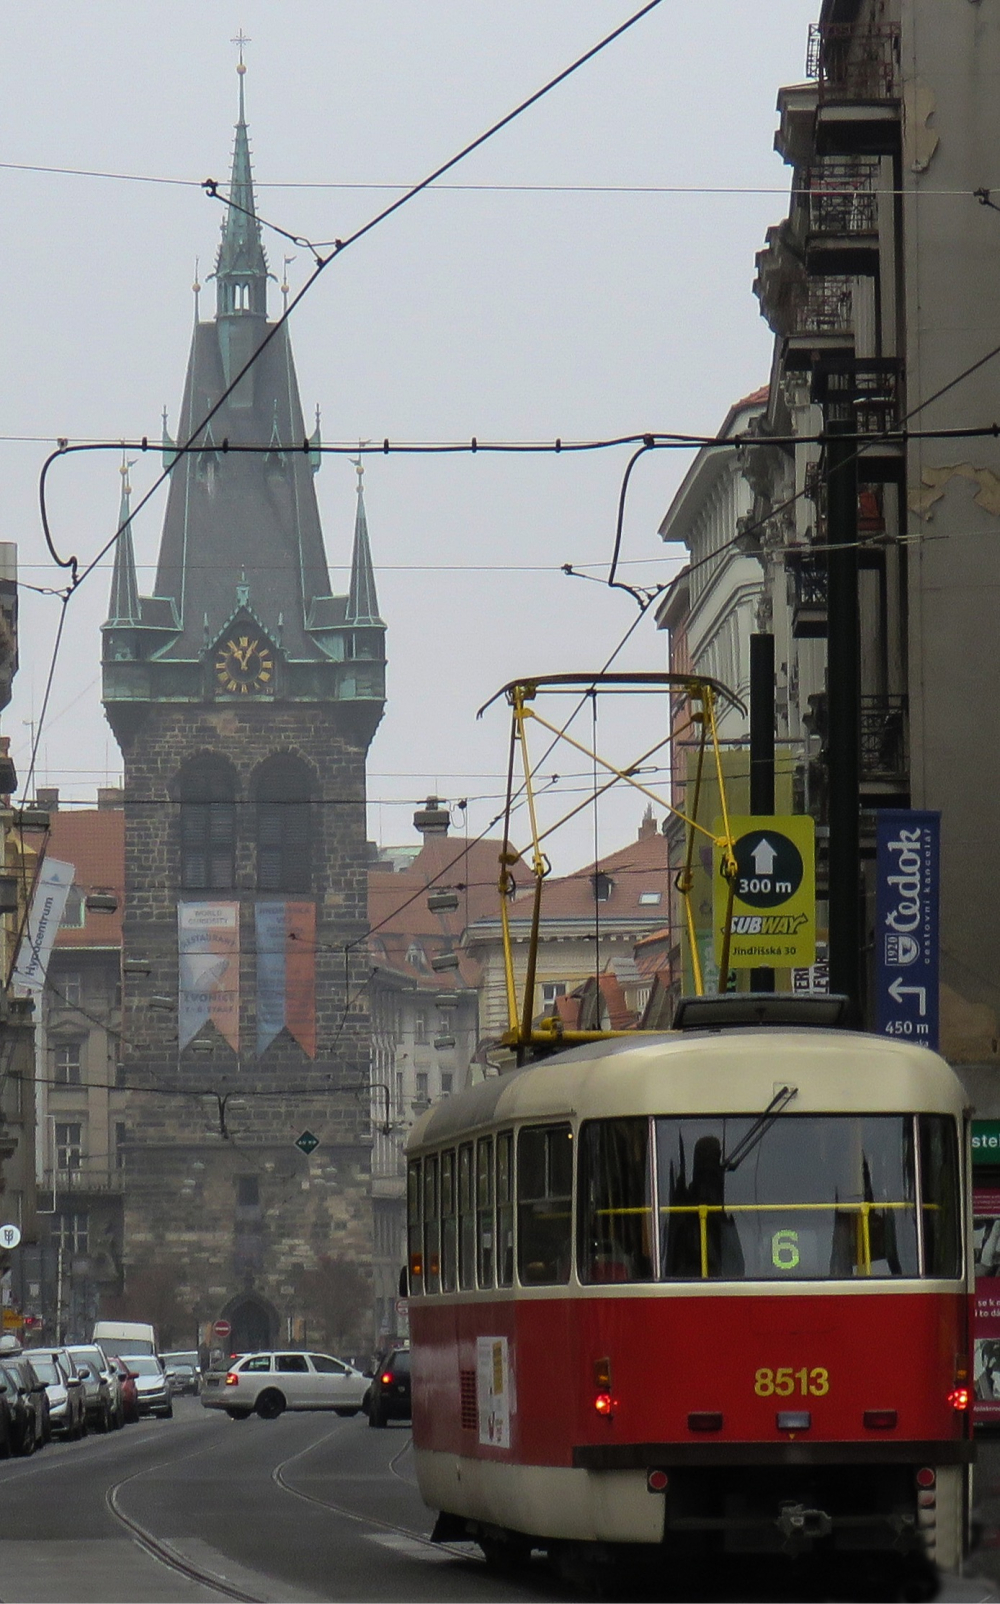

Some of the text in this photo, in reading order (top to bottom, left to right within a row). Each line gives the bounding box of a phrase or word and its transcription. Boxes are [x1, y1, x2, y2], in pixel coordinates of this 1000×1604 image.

[739, 879, 792, 894] 300 m
[885, 827, 921, 933] Čedok
[24, 896, 54, 976] Hypocentrum
[720, 912, 809, 936] SUBWAY
[732, 946, 797, 956] Jindřišská 30
[887, 936, 898, 962] 1920
[885, 1020, 929, 1035] 450 m
[771, 1229, 800, 1270] 6
[754, 1366, 830, 1397] 8513
